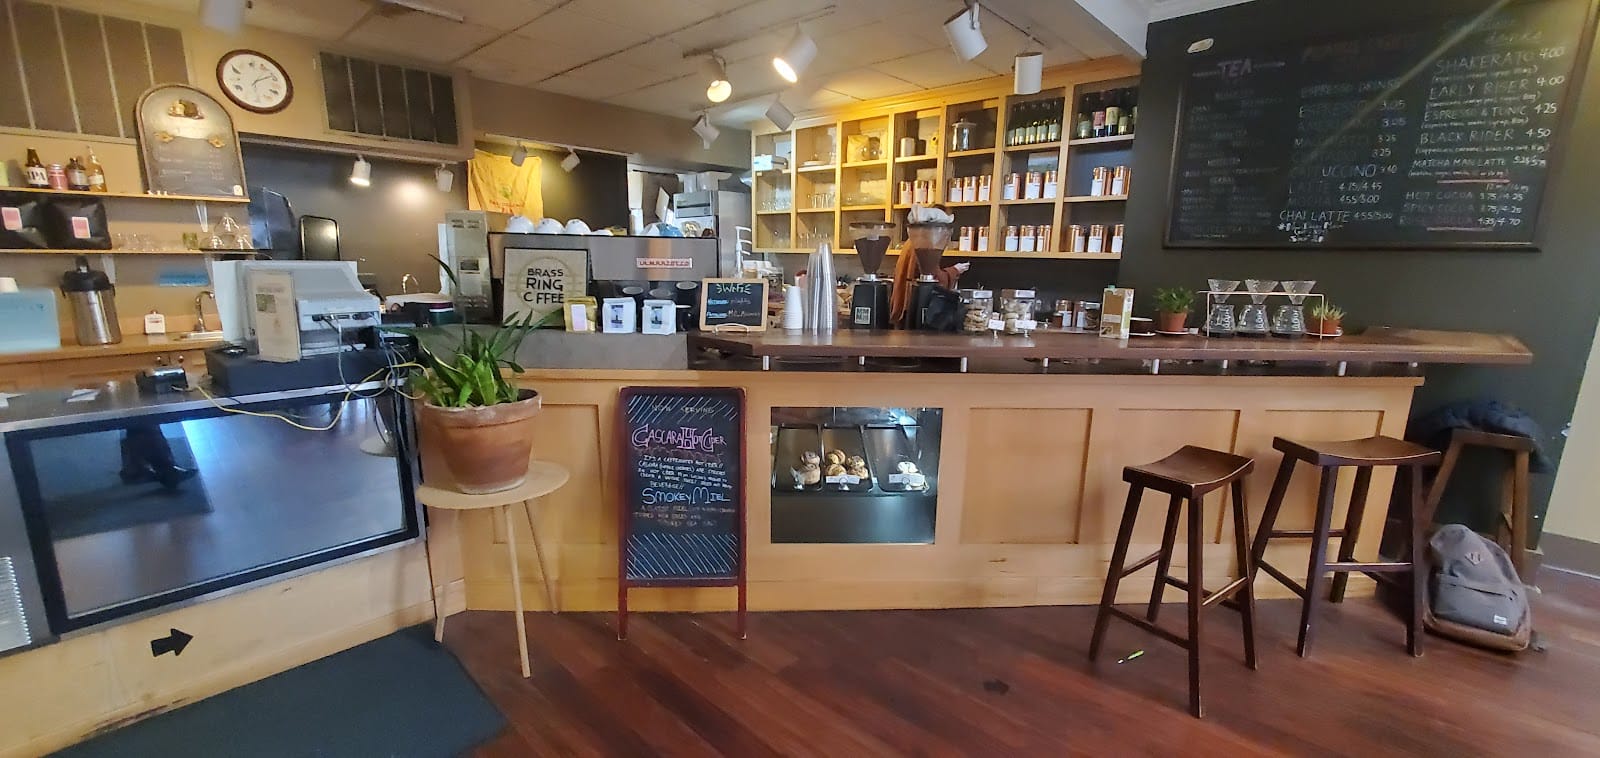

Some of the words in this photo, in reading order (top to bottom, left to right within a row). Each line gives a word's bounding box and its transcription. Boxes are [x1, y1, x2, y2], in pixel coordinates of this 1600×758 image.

[1217, 58, 1252, 80] TEA
[1429, 83, 1475, 100] EARLY
[1420, 131, 1463, 145] BLACK
[1469, 128, 1514, 142] RIDER
[1411, 158, 1451, 169] MATCHA
[1476, 157, 1506, 168] LATTE
[1405, 191, 1431, 201] HOT
[1279, 209, 1307, 221] CHAI
[1311, 209, 1351, 223] LATTE
[527, 268, 564, 278] BRASS
[526, 276, 564, 292] RING
[631, 424, 681, 448] CASCARA
[700, 427, 728, 453] CIDER
[641, 487, 692, 505] SMOKEY
[692, 486, 732, 505] MIEL
